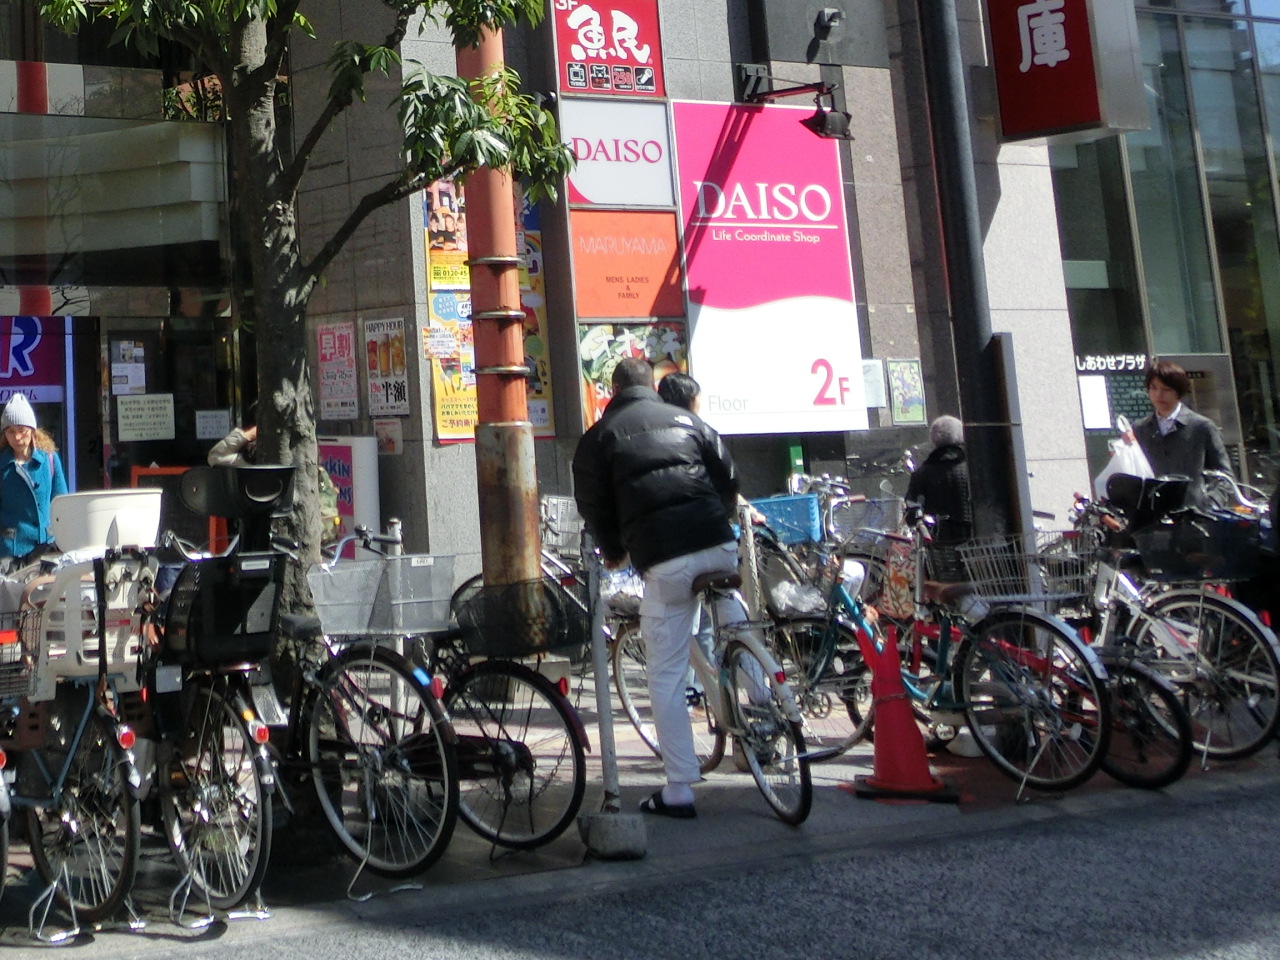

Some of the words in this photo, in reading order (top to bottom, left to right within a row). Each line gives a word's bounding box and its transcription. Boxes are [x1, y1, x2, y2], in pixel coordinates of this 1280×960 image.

[573, 137, 663, 164] DAISO
[693, 181, 832, 221] DAISO
[712, 230, 732, 241] Life
[735, 230, 791, 242] Coordinate
[794, 232, 821, 244] Shop
[580, 237, 669, 255] MARUYAMA
[605, 276, 624, 284] MENS
[366, 323, 385, 333] HAPPY
[386, 321, 404, 331] HOUR
[1076, 355, 1146, 370] しあわせプラザ
[811, 358, 850, 406] 2F
[708, 395, 748, 411] Floor
